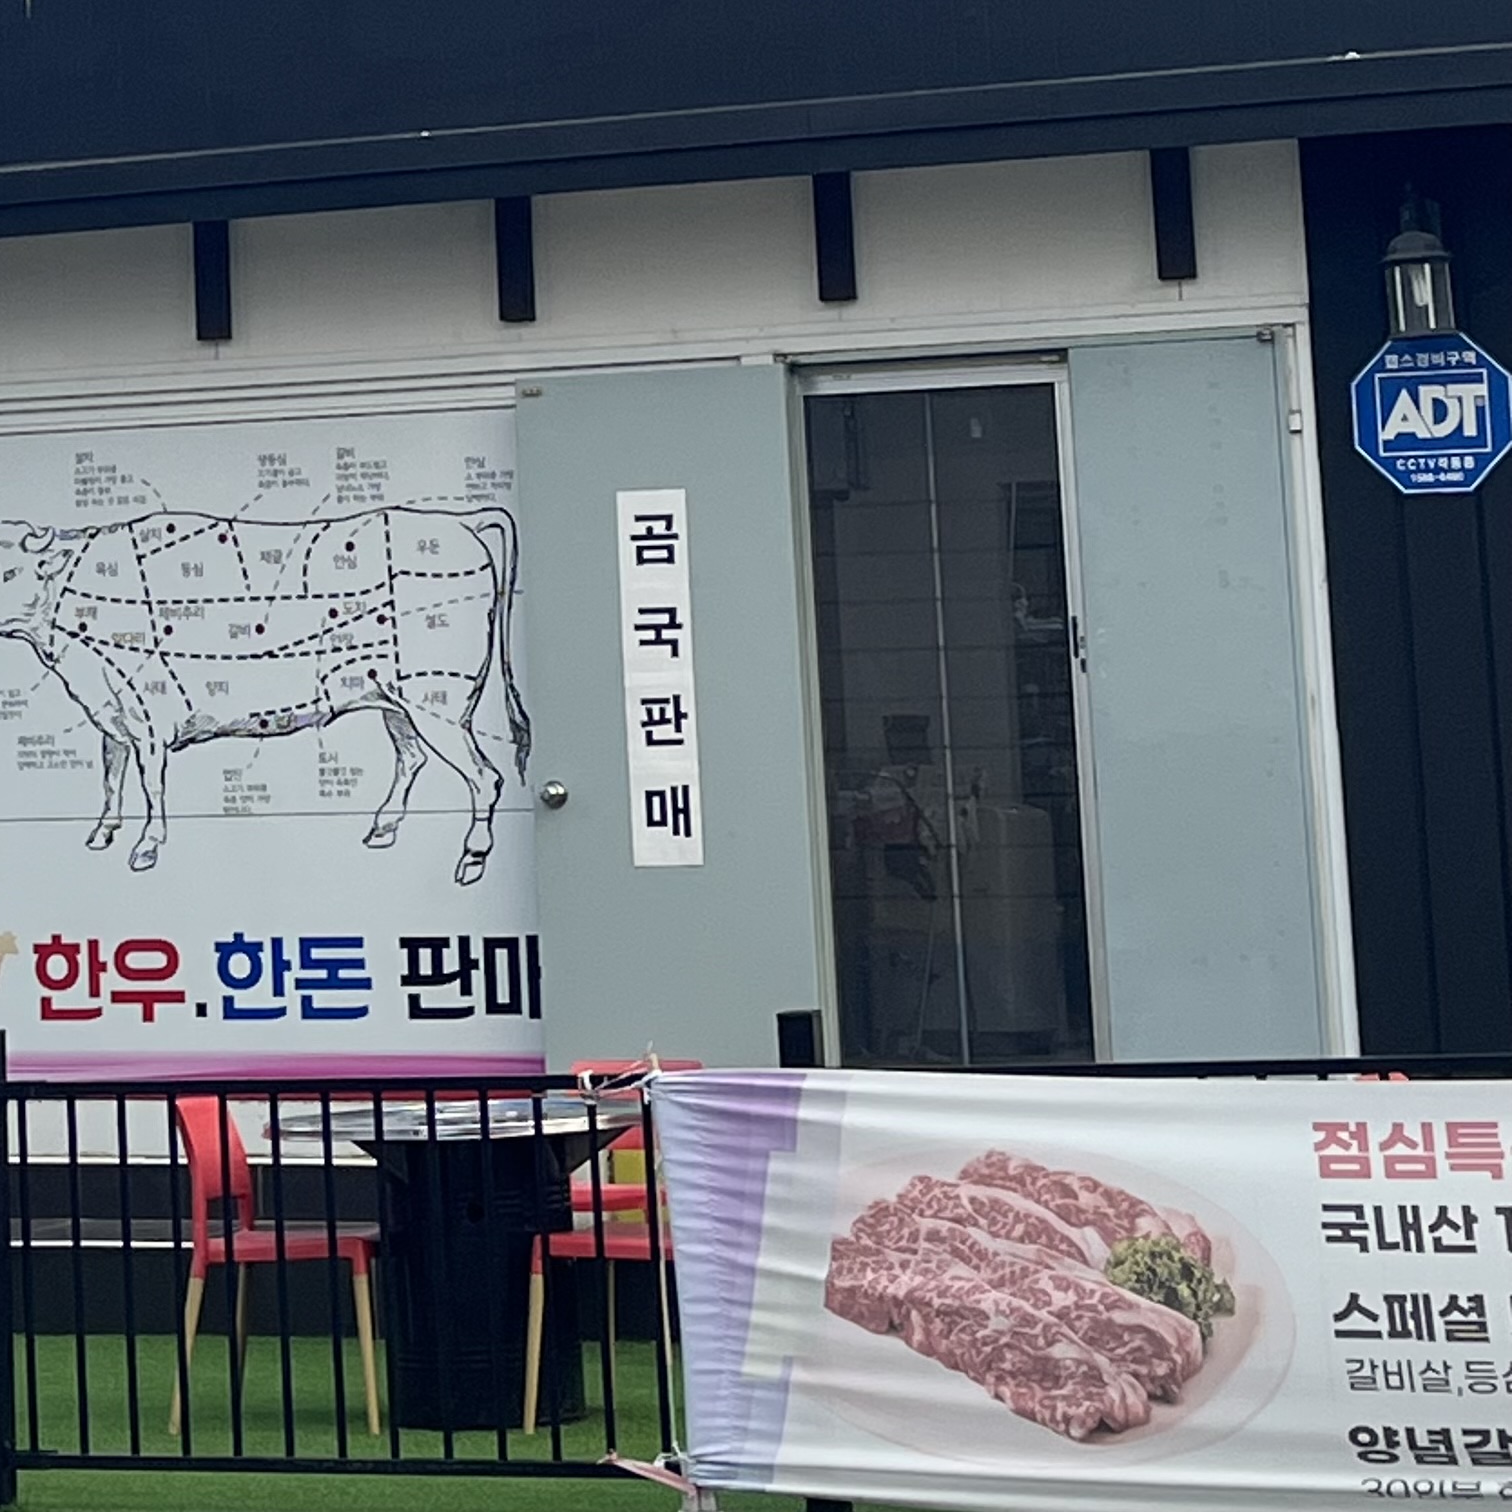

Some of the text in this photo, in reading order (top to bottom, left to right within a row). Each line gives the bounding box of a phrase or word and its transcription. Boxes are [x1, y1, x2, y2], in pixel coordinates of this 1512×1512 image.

[1382, 385, 1487, 439] ADT
[181, 561, 205, 578] 등심
[333, 554, 359, 570] 안심
[32, 932, 374, 1023] 한우.한돈
[1312, 1121, 1512, 1180] 점심특
[1321, 1204, 1479, 1254] 국내산
[1332, 1292, 1491, 1343] 스페셜
